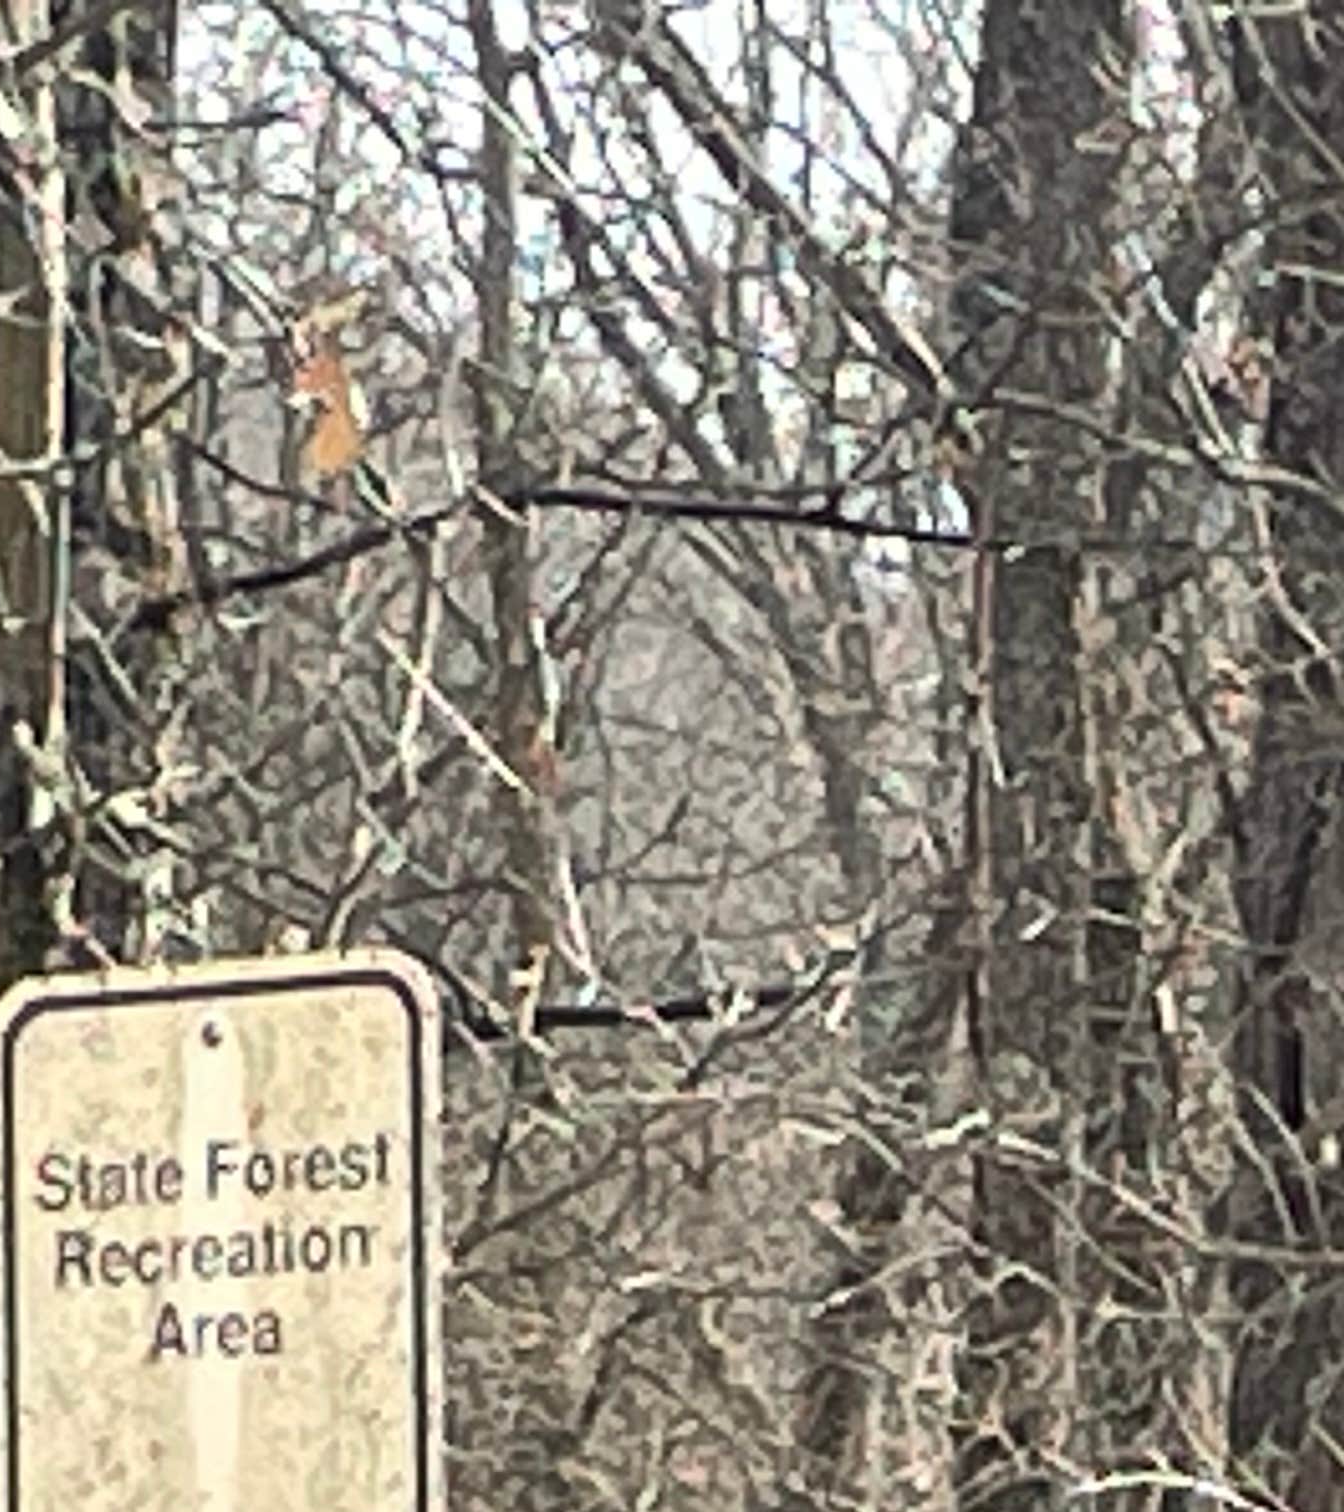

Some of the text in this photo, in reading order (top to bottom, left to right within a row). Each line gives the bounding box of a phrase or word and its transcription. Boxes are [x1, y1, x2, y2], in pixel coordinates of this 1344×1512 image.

[34, 1132, 392, 1213] State Forest
[56, 1222, 376, 1289] Recreation
[149, 1301, 283, 1360] Area
